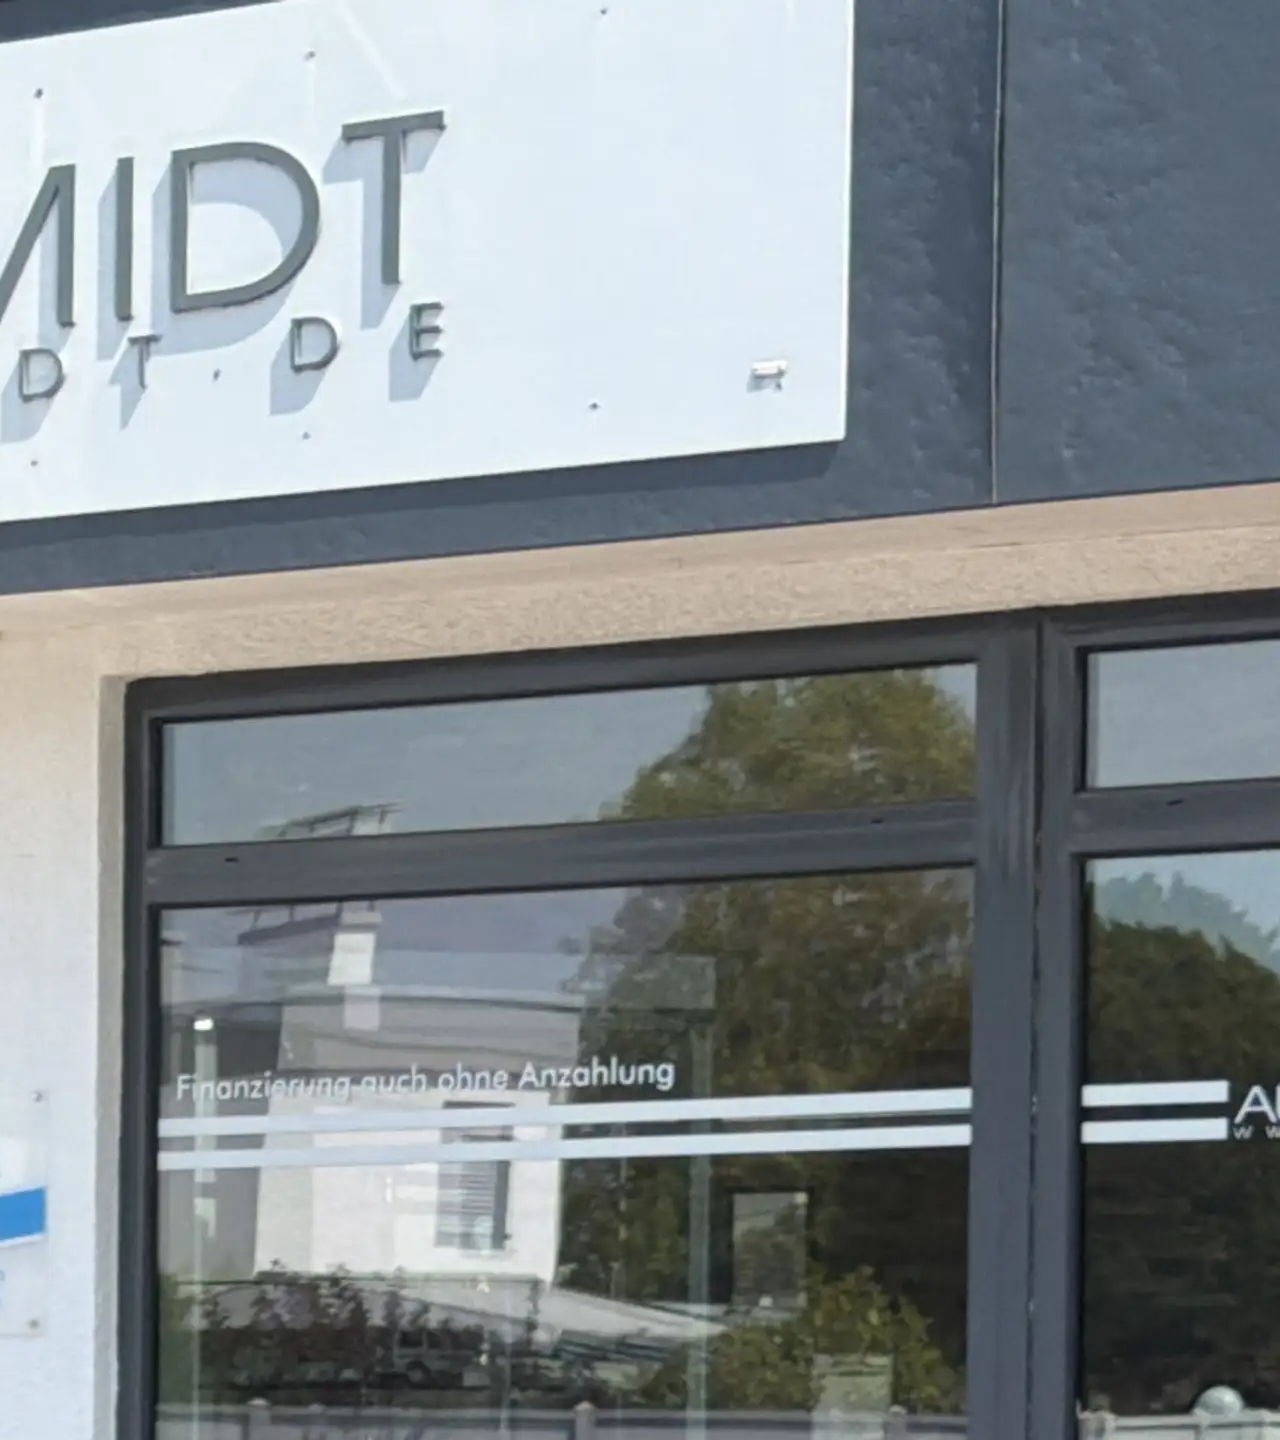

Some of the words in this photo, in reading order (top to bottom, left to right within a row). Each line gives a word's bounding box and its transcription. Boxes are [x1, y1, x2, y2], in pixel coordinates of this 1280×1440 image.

[175, 1070, 352, 1101] Finanzierung
[360, 1064, 427, 1096] auch
[439, 1063, 509, 1093] ohne
[519, 1055, 676, 1093] Anzahlung
